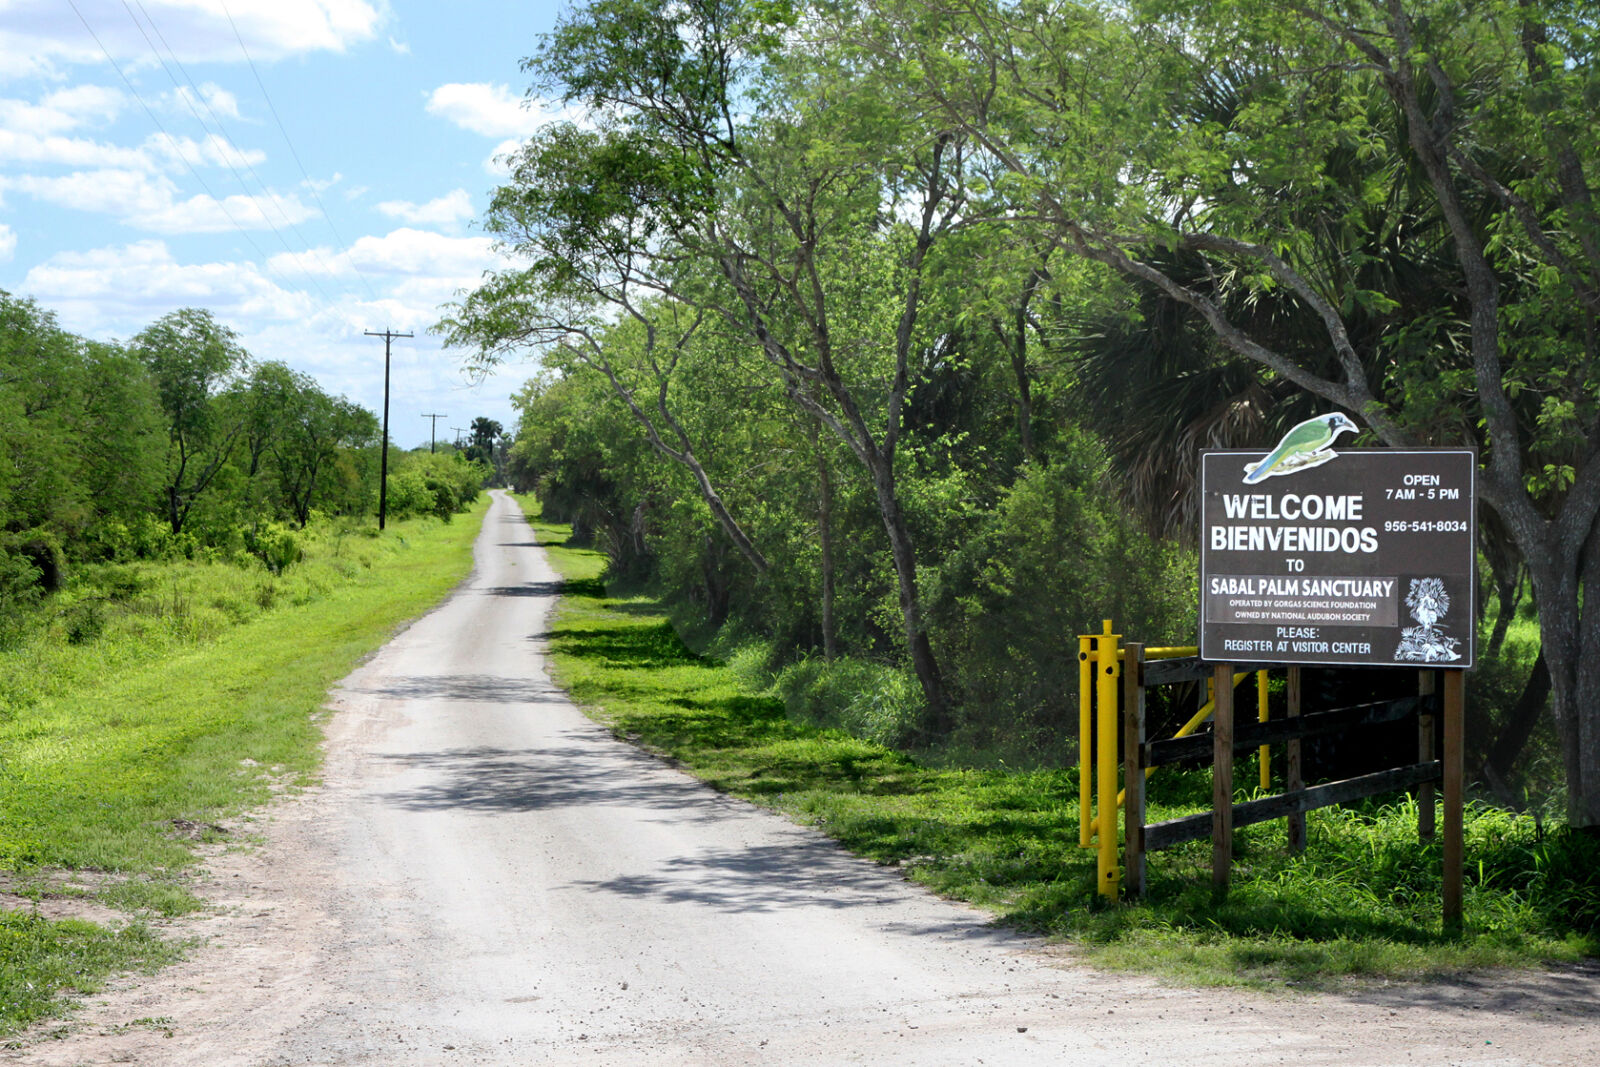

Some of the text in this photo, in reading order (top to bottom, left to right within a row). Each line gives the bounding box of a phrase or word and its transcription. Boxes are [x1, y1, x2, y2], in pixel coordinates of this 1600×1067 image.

[1403, 475, 1440, 486] OPEN
[1427, 489, 1436, 500] 5
[1439, 489, 1460, 500] PM
[1222, 494, 1363, 521] WELCOME
[1384, 521, 1468, 532] 956-541-8034
[1211, 526, 1379, 553] BIENVENIDOS
[1286, 559, 1305, 572] TO
[1211, 578, 1394, 597] SABAL PALM SANCTUARY
[1274, 600, 1301, 608] GORGAS
[1302, 601, 1330, 609] SCIENCE
[1330, 601, 1377, 610] FOUNDATION
[1271, 612, 1306, 620] NATIONAL
[1342, 613, 1370, 621] SOCIETY
[1276, 627, 1320, 638] PLEASE:
[1224, 639, 1371, 654] REGISTER AT VISITOR CENTER
